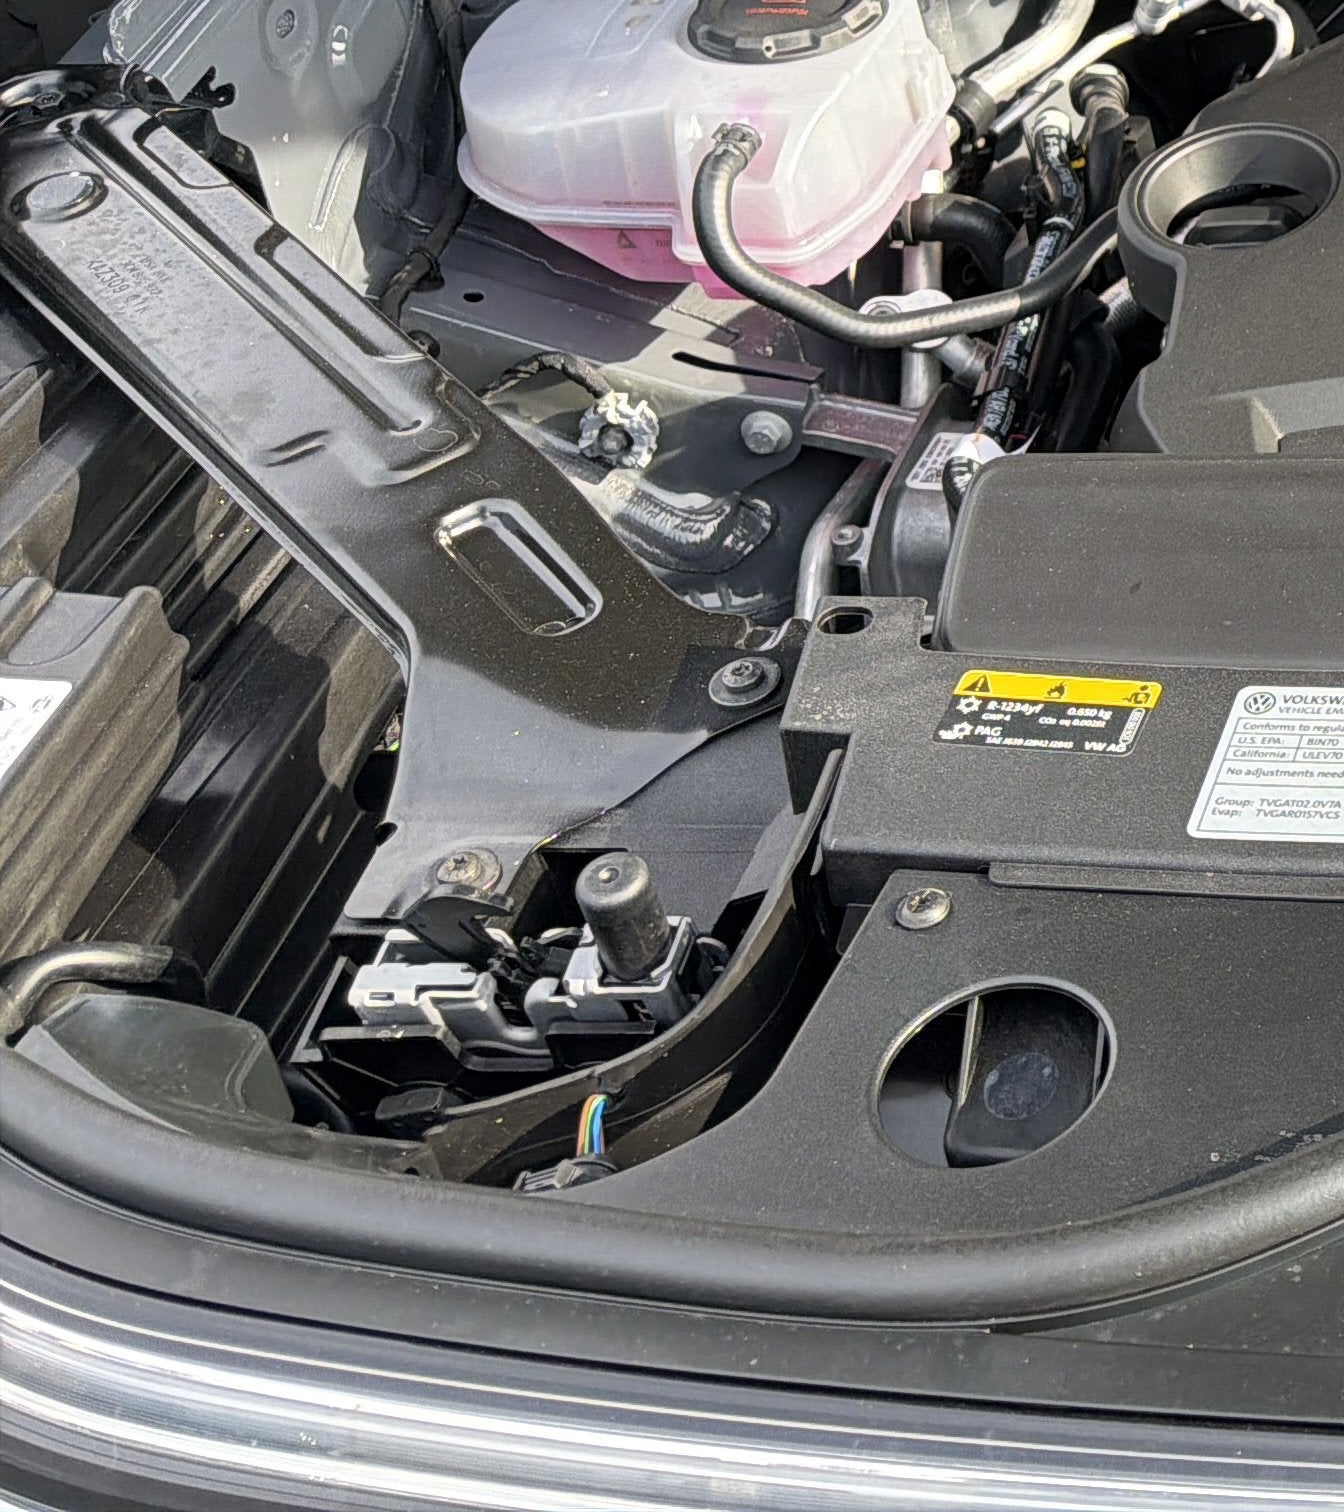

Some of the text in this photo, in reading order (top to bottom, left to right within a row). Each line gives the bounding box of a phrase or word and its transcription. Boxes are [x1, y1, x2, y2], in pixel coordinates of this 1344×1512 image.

[987, 700, 1045, 716] R-1234yf
[1278, 706, 1323, 714] VEHICLE
[974, 725, 1003, 737] PAG
[1243, 721, 1296, 732] Conforms
[1298, 723, 1311, 732] to
[1084, 741, 1127, 753] VW AG
[1305, 738, 1340, 746] BIN70
[1232, 748, 1290, 759] California:
[1302, 752, 1343, 760] ULEV70
[1226, 766, 1242, 776] No
[1244, 767, 1315, 779] adjustments
[1214, 796, 1254, 808] Group:
[1211, 807, 1242, 818] Evap:
